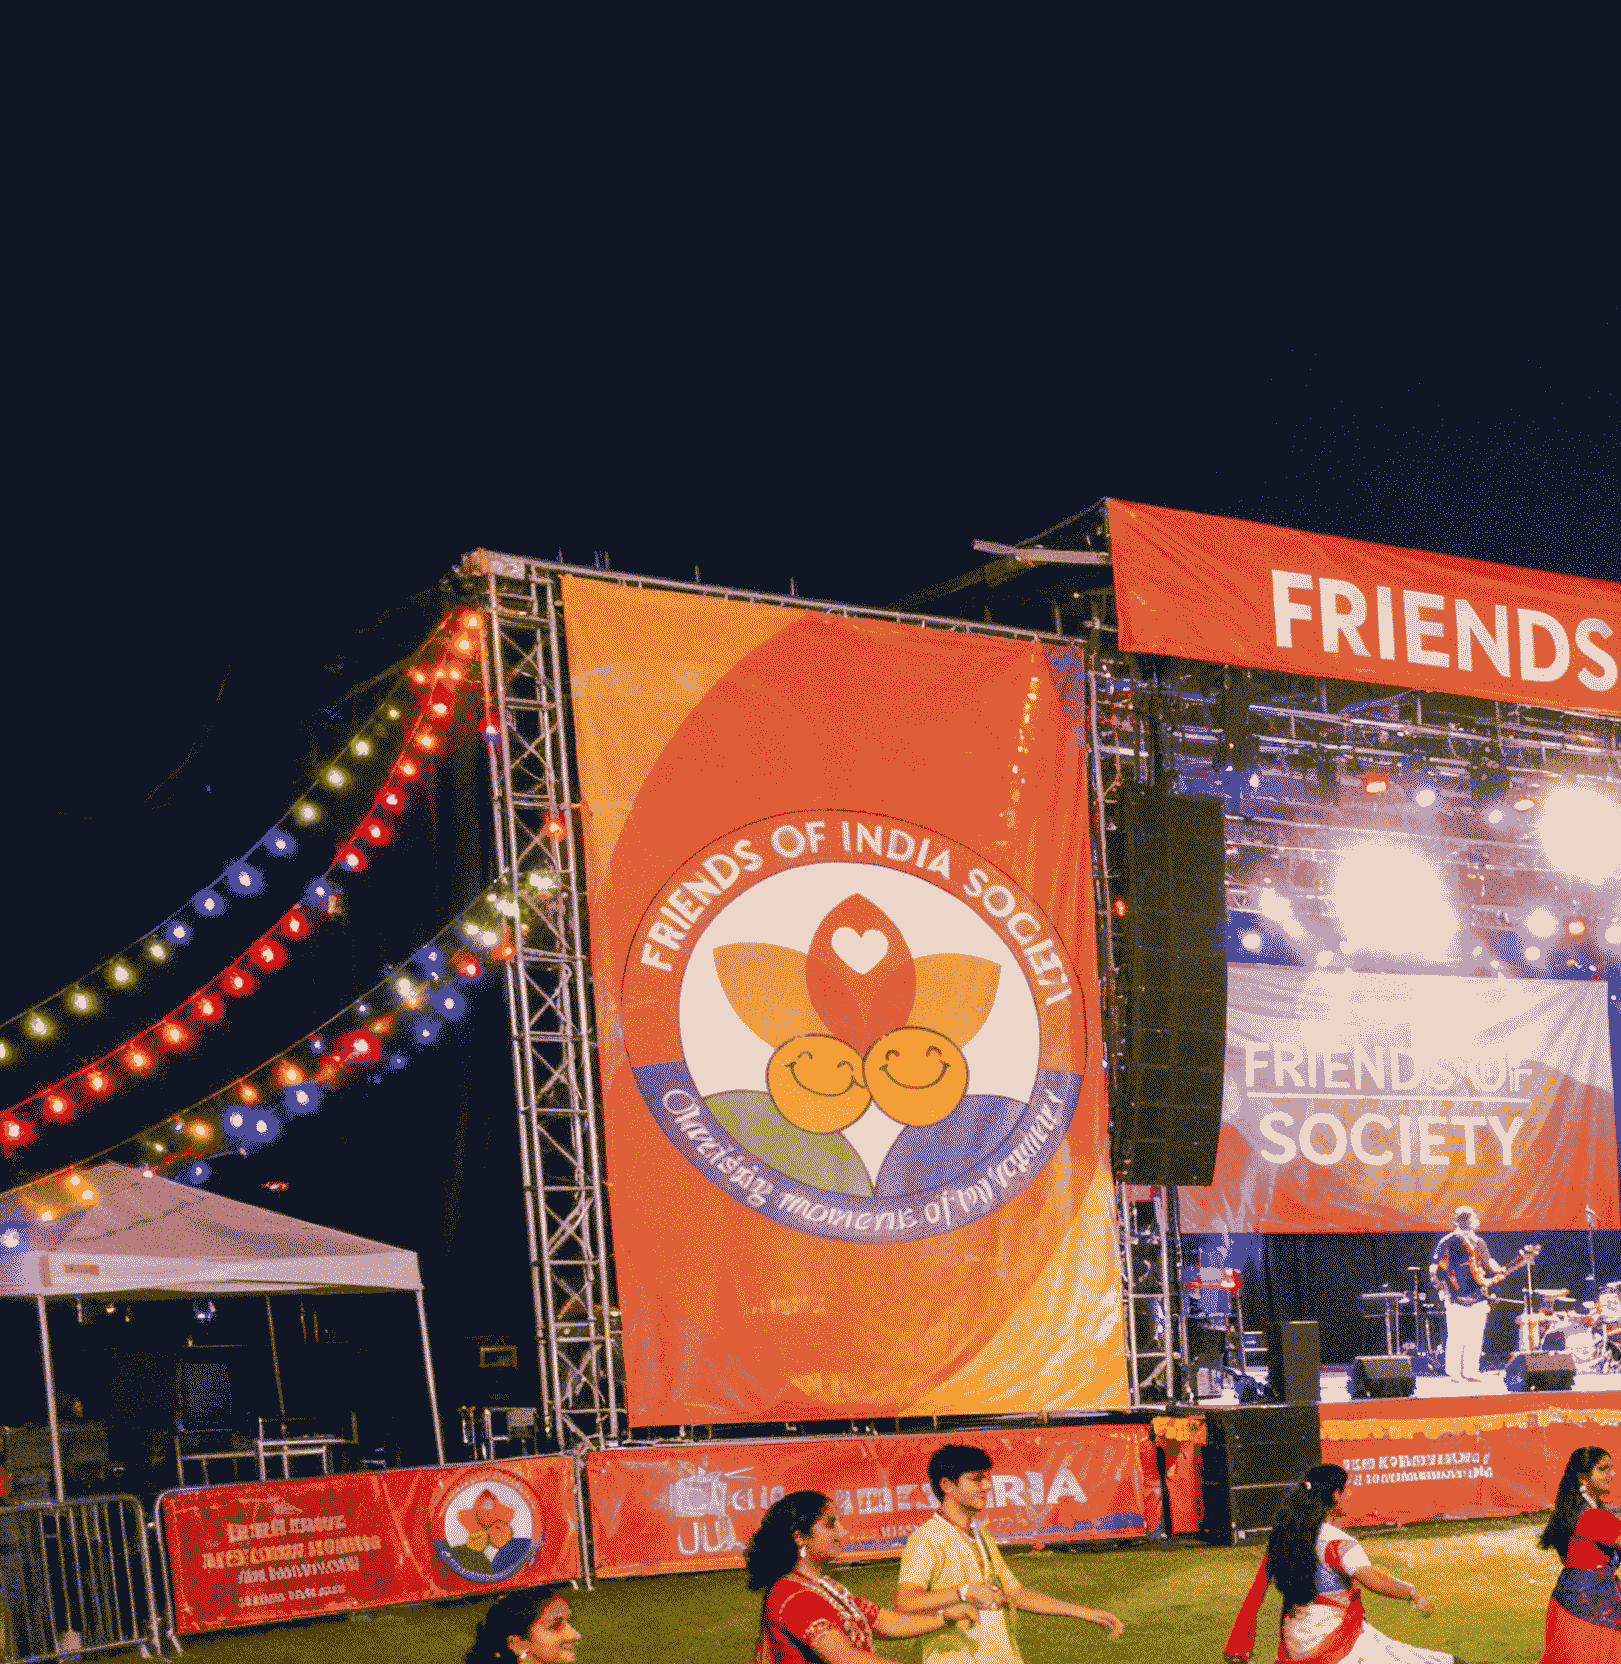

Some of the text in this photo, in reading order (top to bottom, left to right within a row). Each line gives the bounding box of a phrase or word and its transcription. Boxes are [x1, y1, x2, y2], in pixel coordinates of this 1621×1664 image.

[1272, 569, 1618, 692] FRIENDS
[640, 838, 764, 972] FRIENDS
[771, 820, 827, 859] OF
[841, 820, 953, 881] INDIA
[1244, 1042, 1455, 1092] FRIENDS
[1258, 1111, 1527, 1167] SOCIETY
